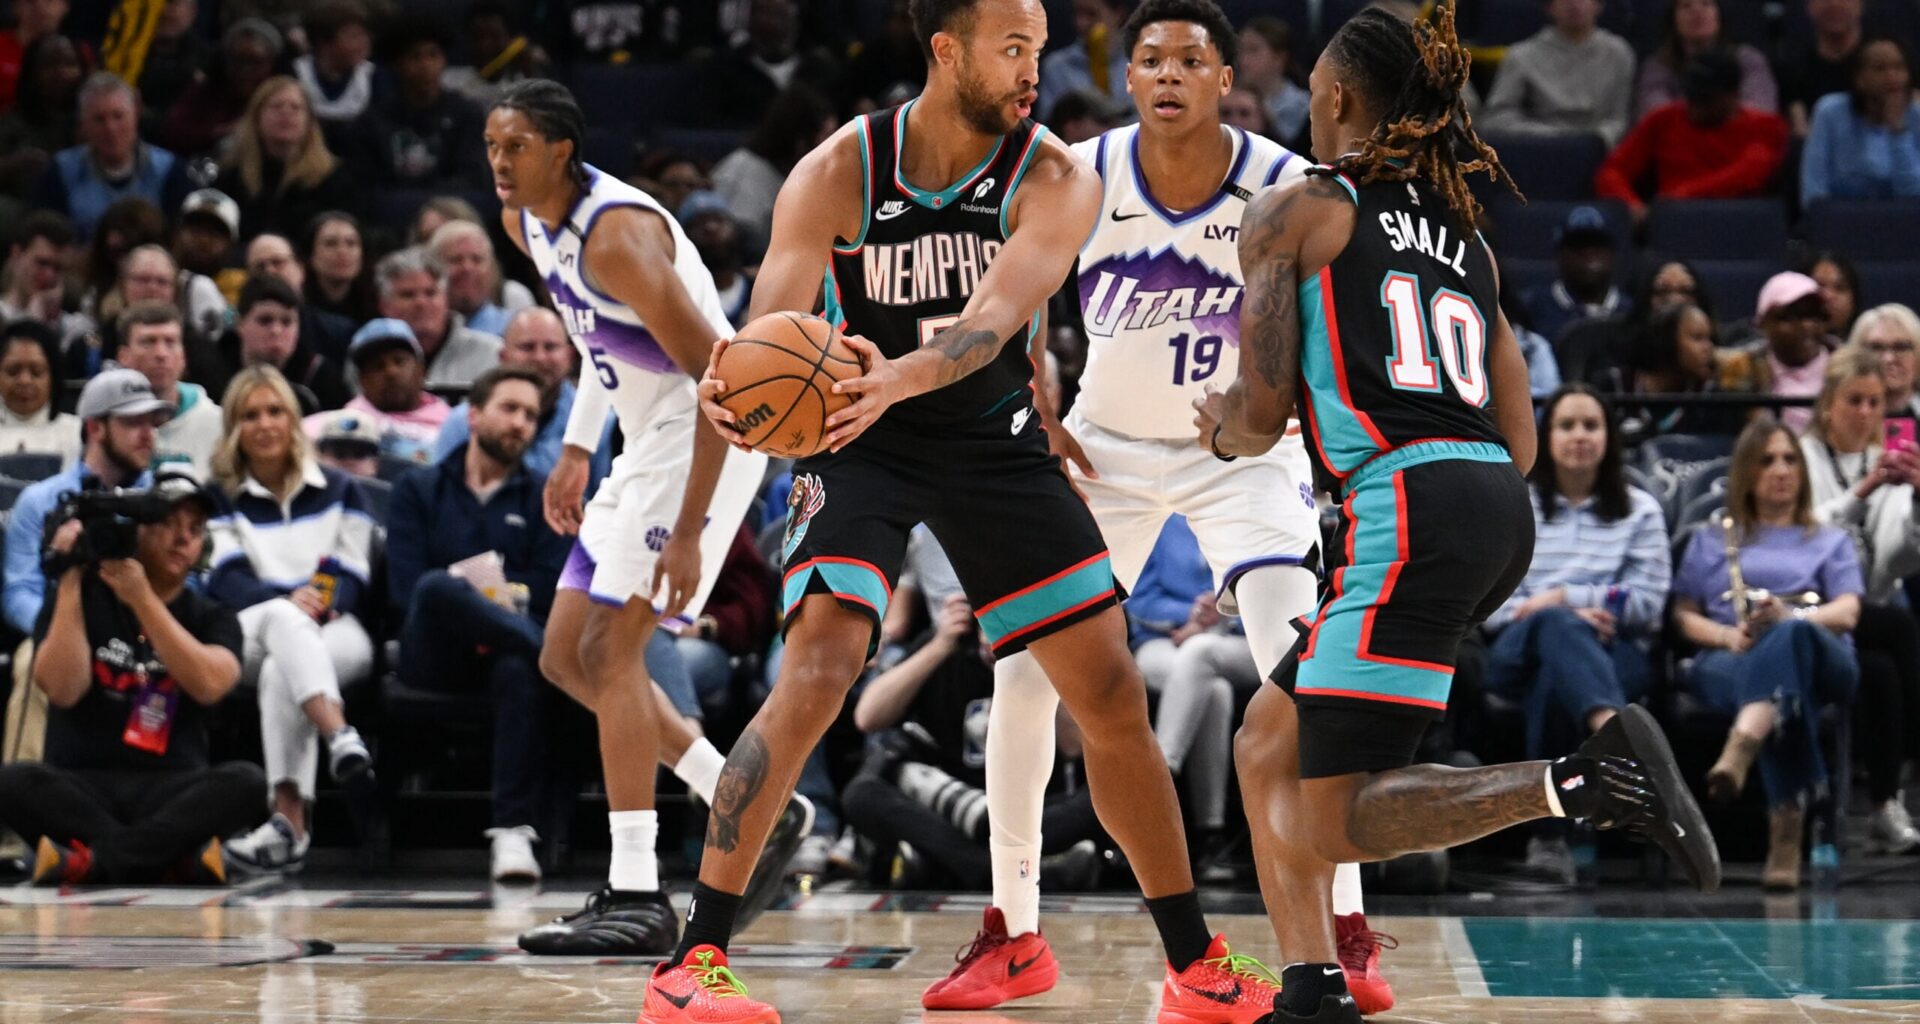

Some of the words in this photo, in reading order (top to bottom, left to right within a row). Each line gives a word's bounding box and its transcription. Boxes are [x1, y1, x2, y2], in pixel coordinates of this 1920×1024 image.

[881, 200, 904, 213] NIKE
[960, 202, 999, 214] Robinhood
[1379, 209, 1467, 278] SMALL
[1084, 270, 1246, 337] UTAH
[1168, 332, 1223, 386] 19
[1380, 269, 1490, 409] 10
[589, 347, 619, 390] 5
